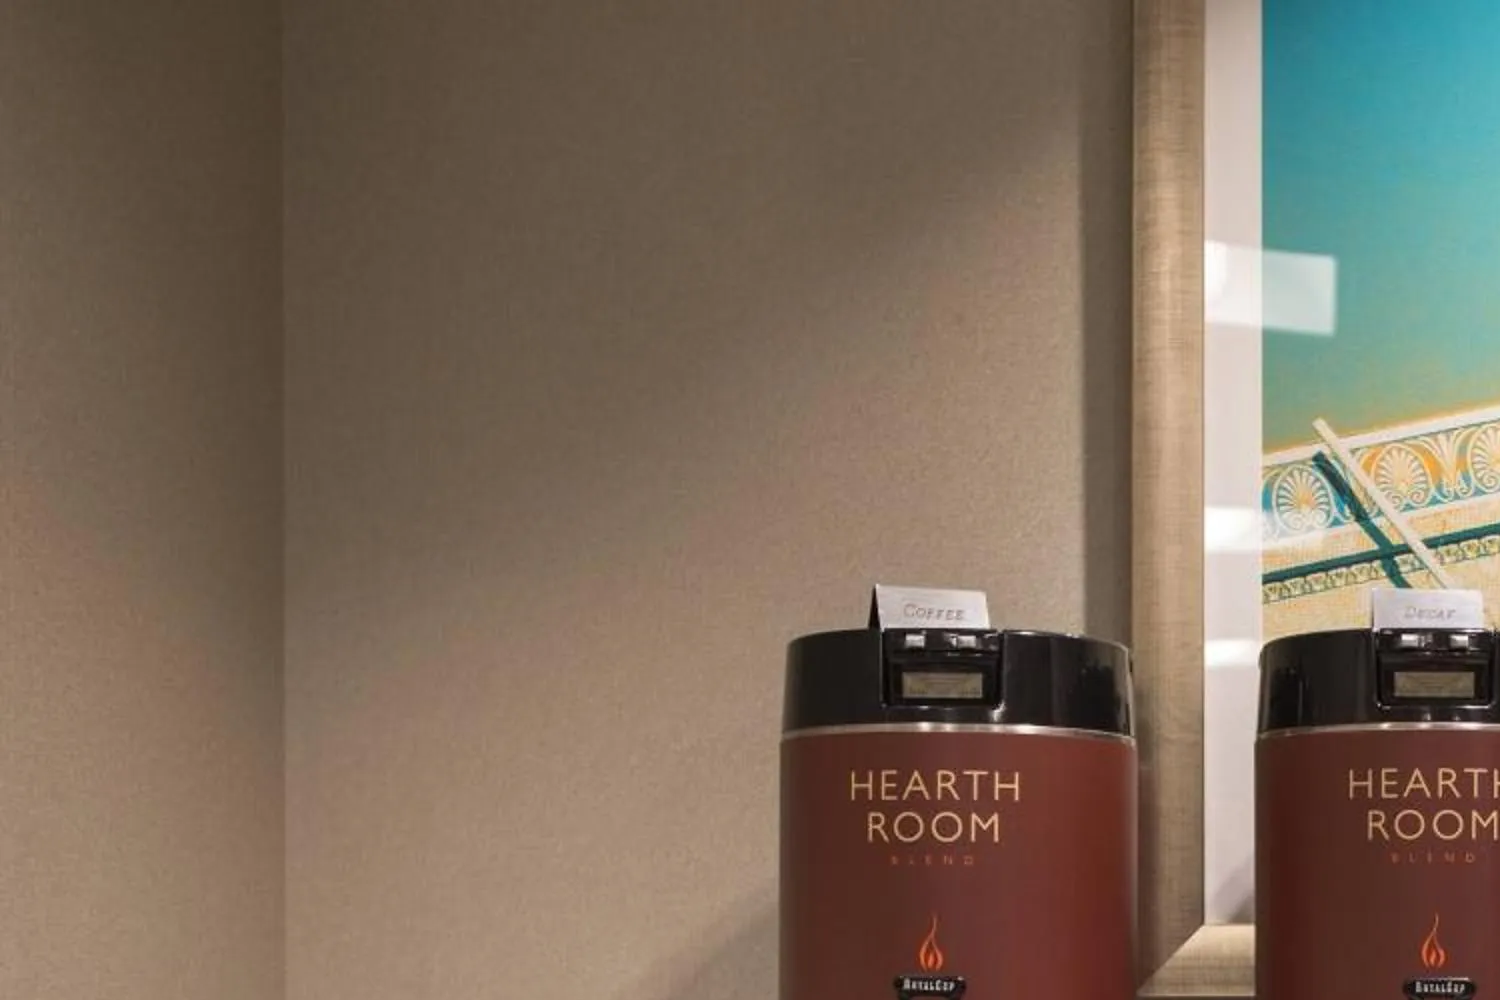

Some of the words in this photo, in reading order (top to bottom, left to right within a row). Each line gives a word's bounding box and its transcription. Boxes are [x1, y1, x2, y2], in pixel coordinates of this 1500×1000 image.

[850, 769, 1020, 802] HEARTH
[866, 811, 1001, 843] ROOM
[1366, 808, 1500, 841] ROOM
